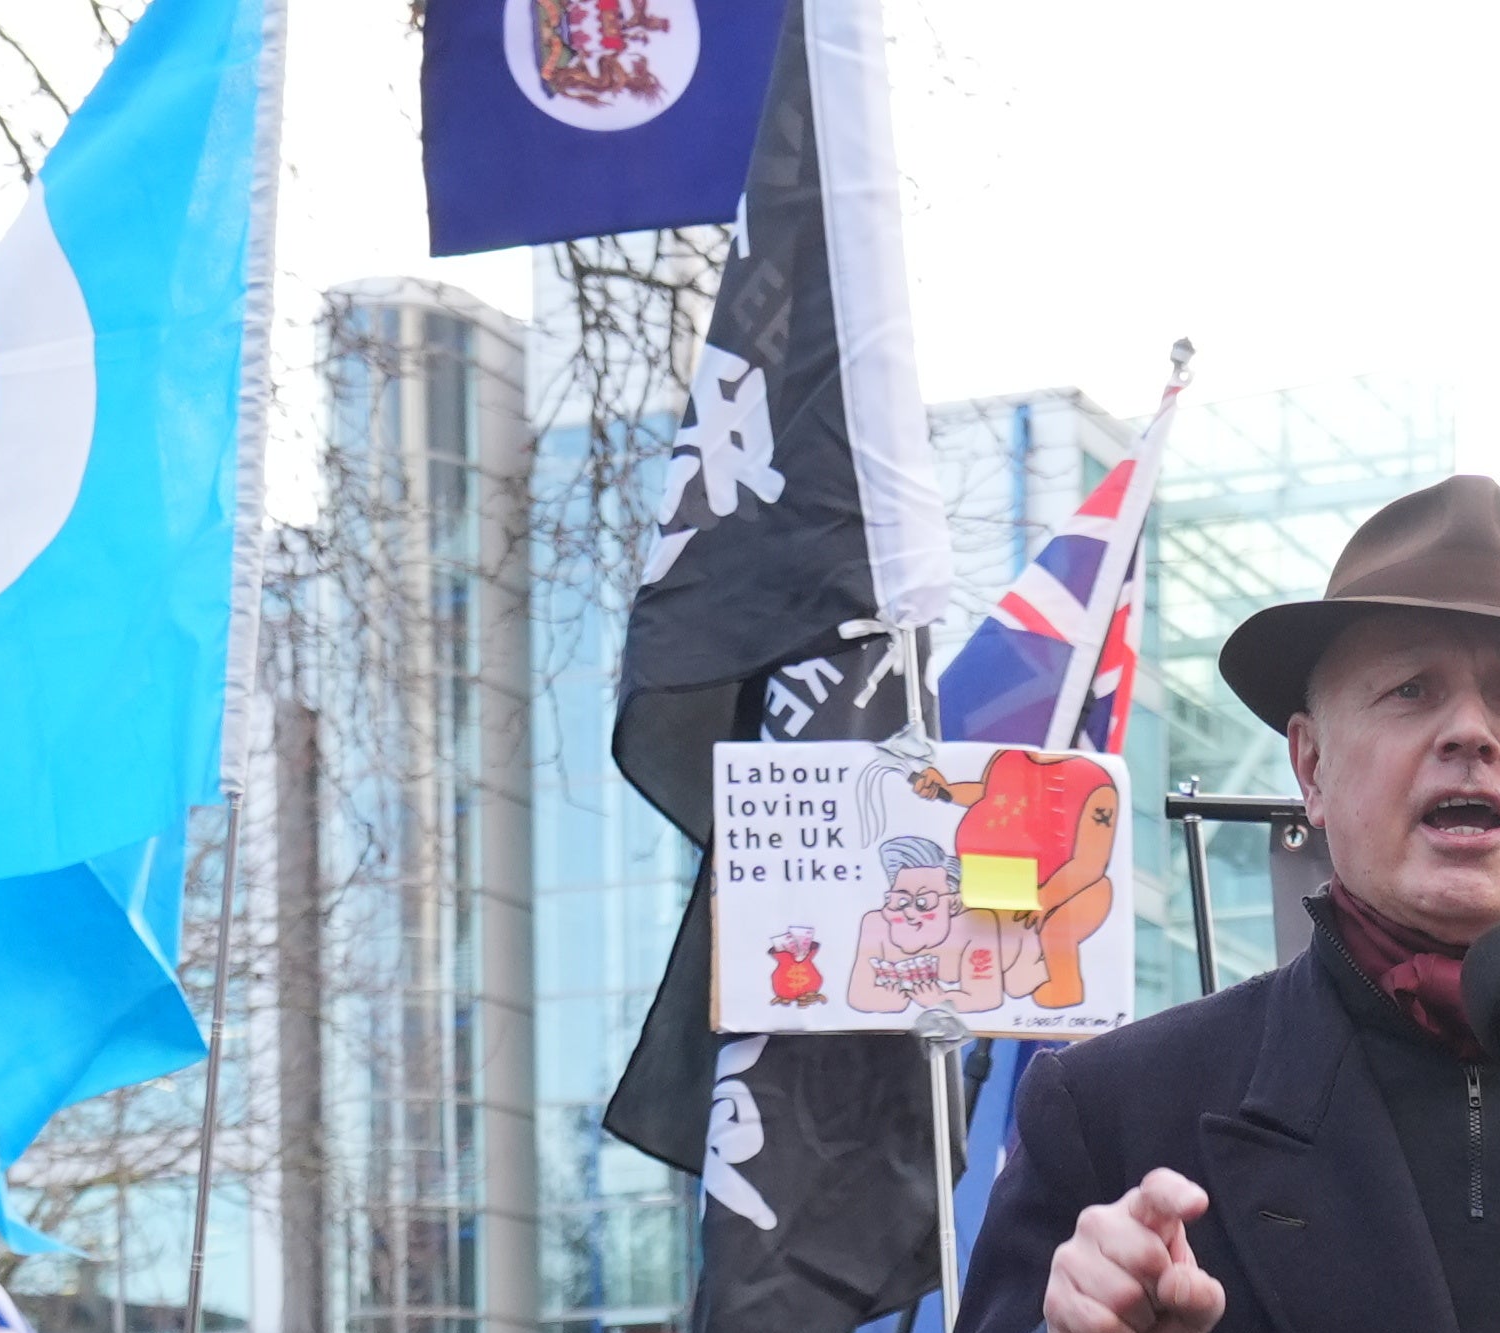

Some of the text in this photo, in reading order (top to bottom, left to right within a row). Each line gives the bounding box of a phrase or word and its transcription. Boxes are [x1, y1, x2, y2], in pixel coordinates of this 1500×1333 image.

[727, 762, 850, 784] Labour
[728, 795, 837, 821] loving
[728, 827, 844, 849] the UK
[729, 859, 863, 883] be like:
